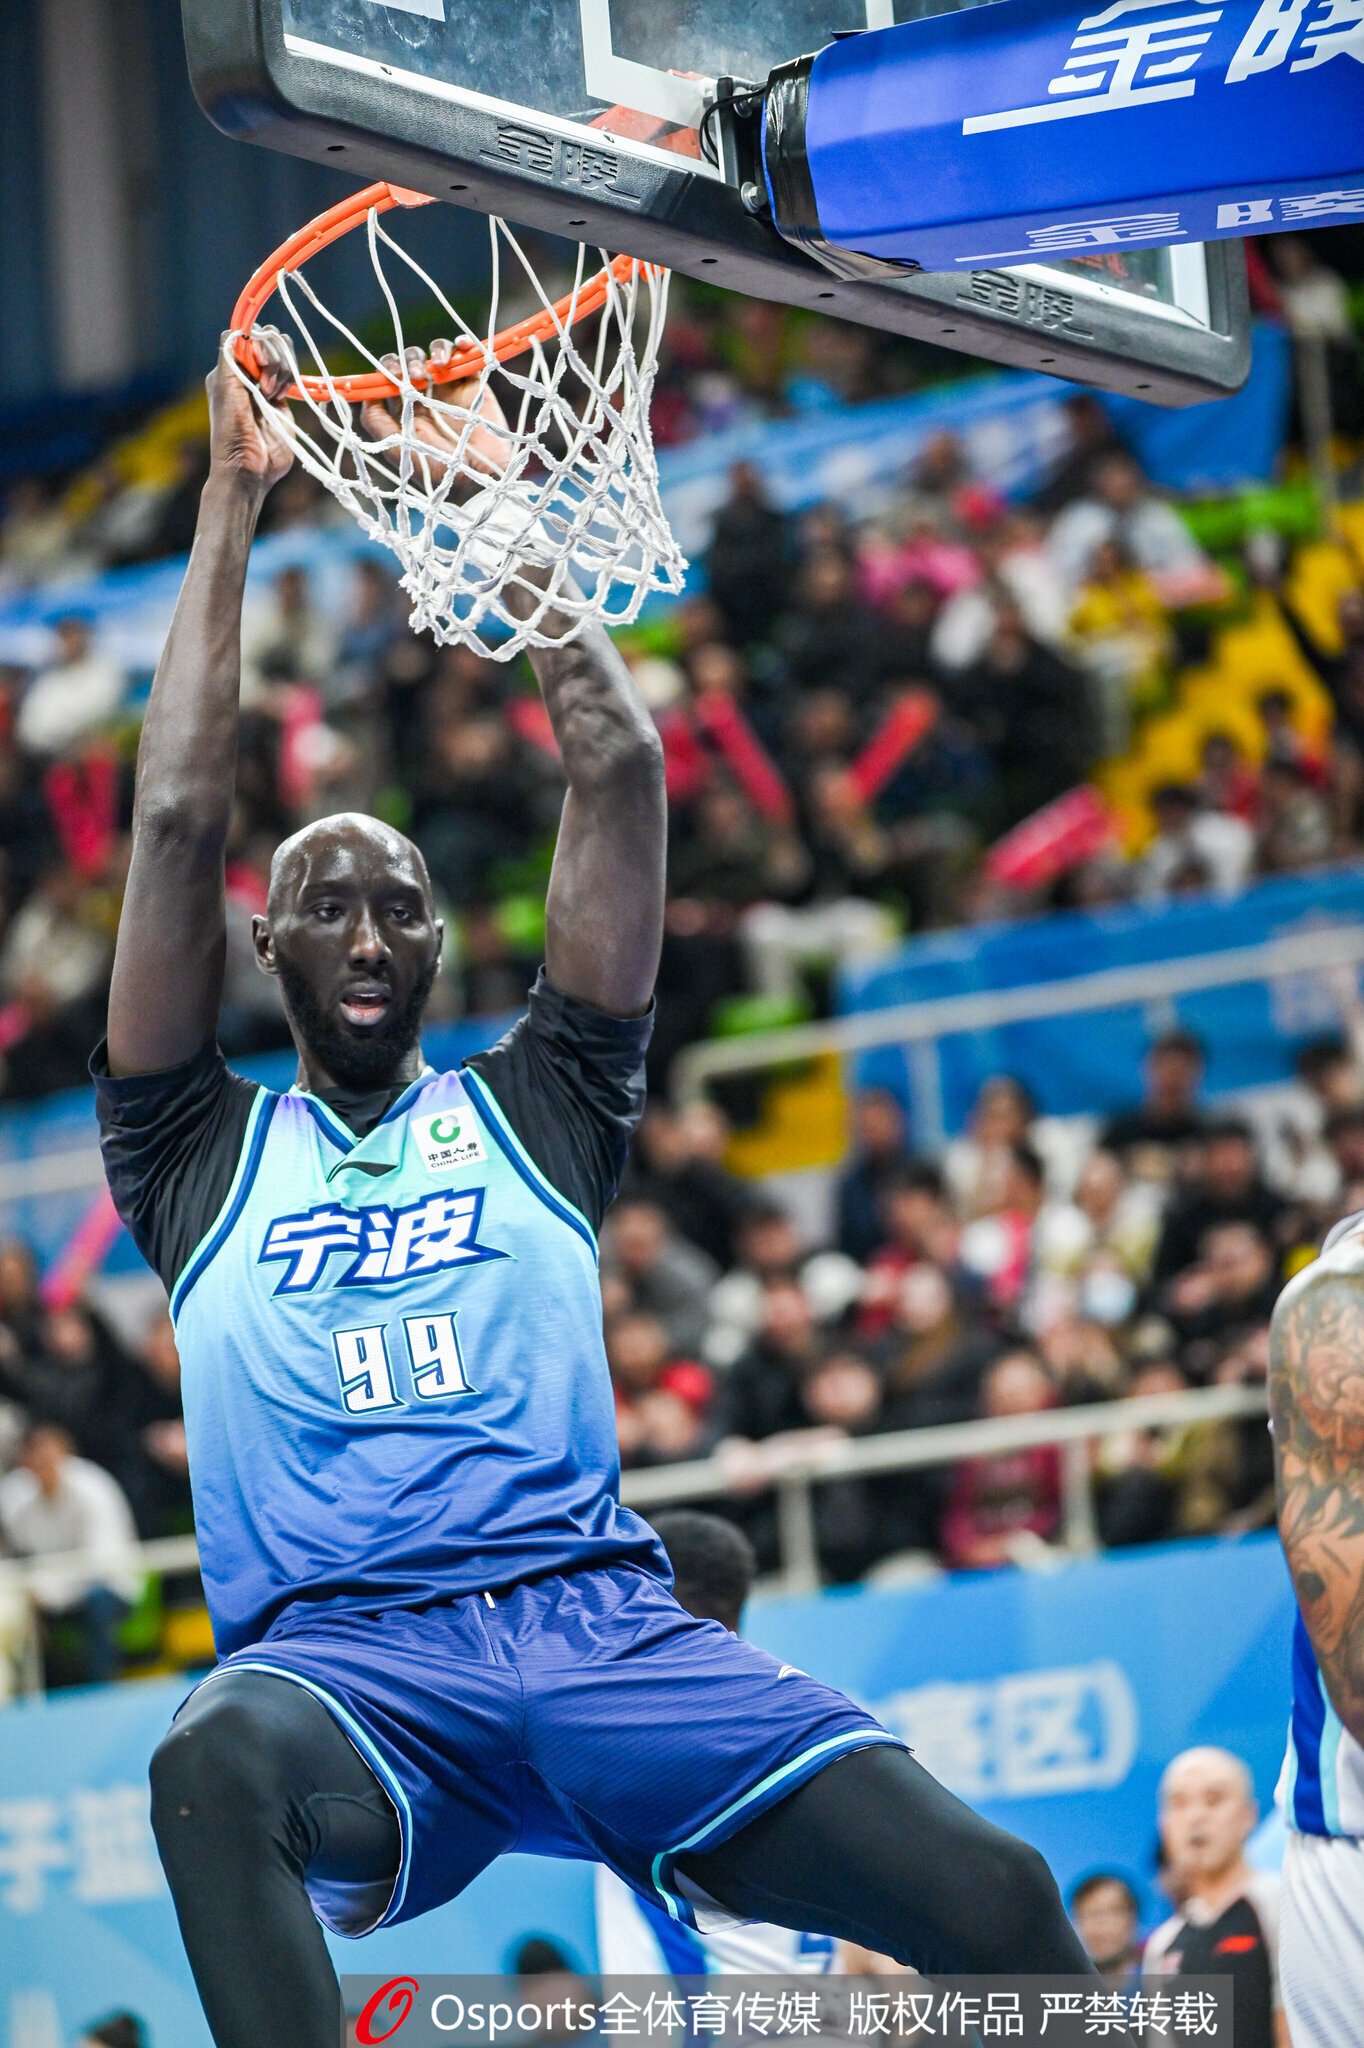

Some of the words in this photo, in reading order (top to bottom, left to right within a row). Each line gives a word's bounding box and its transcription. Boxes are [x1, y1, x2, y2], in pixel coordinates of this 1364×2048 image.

[427, 1141, 478, 1162] 中国人寿
[430, 1157, 459, 1169] CHINA
[460, 1150, 480, 1161] LIFE
[257, 1187, 514, 1298] 宁波
[332, 1311, 480, 1415] 99
